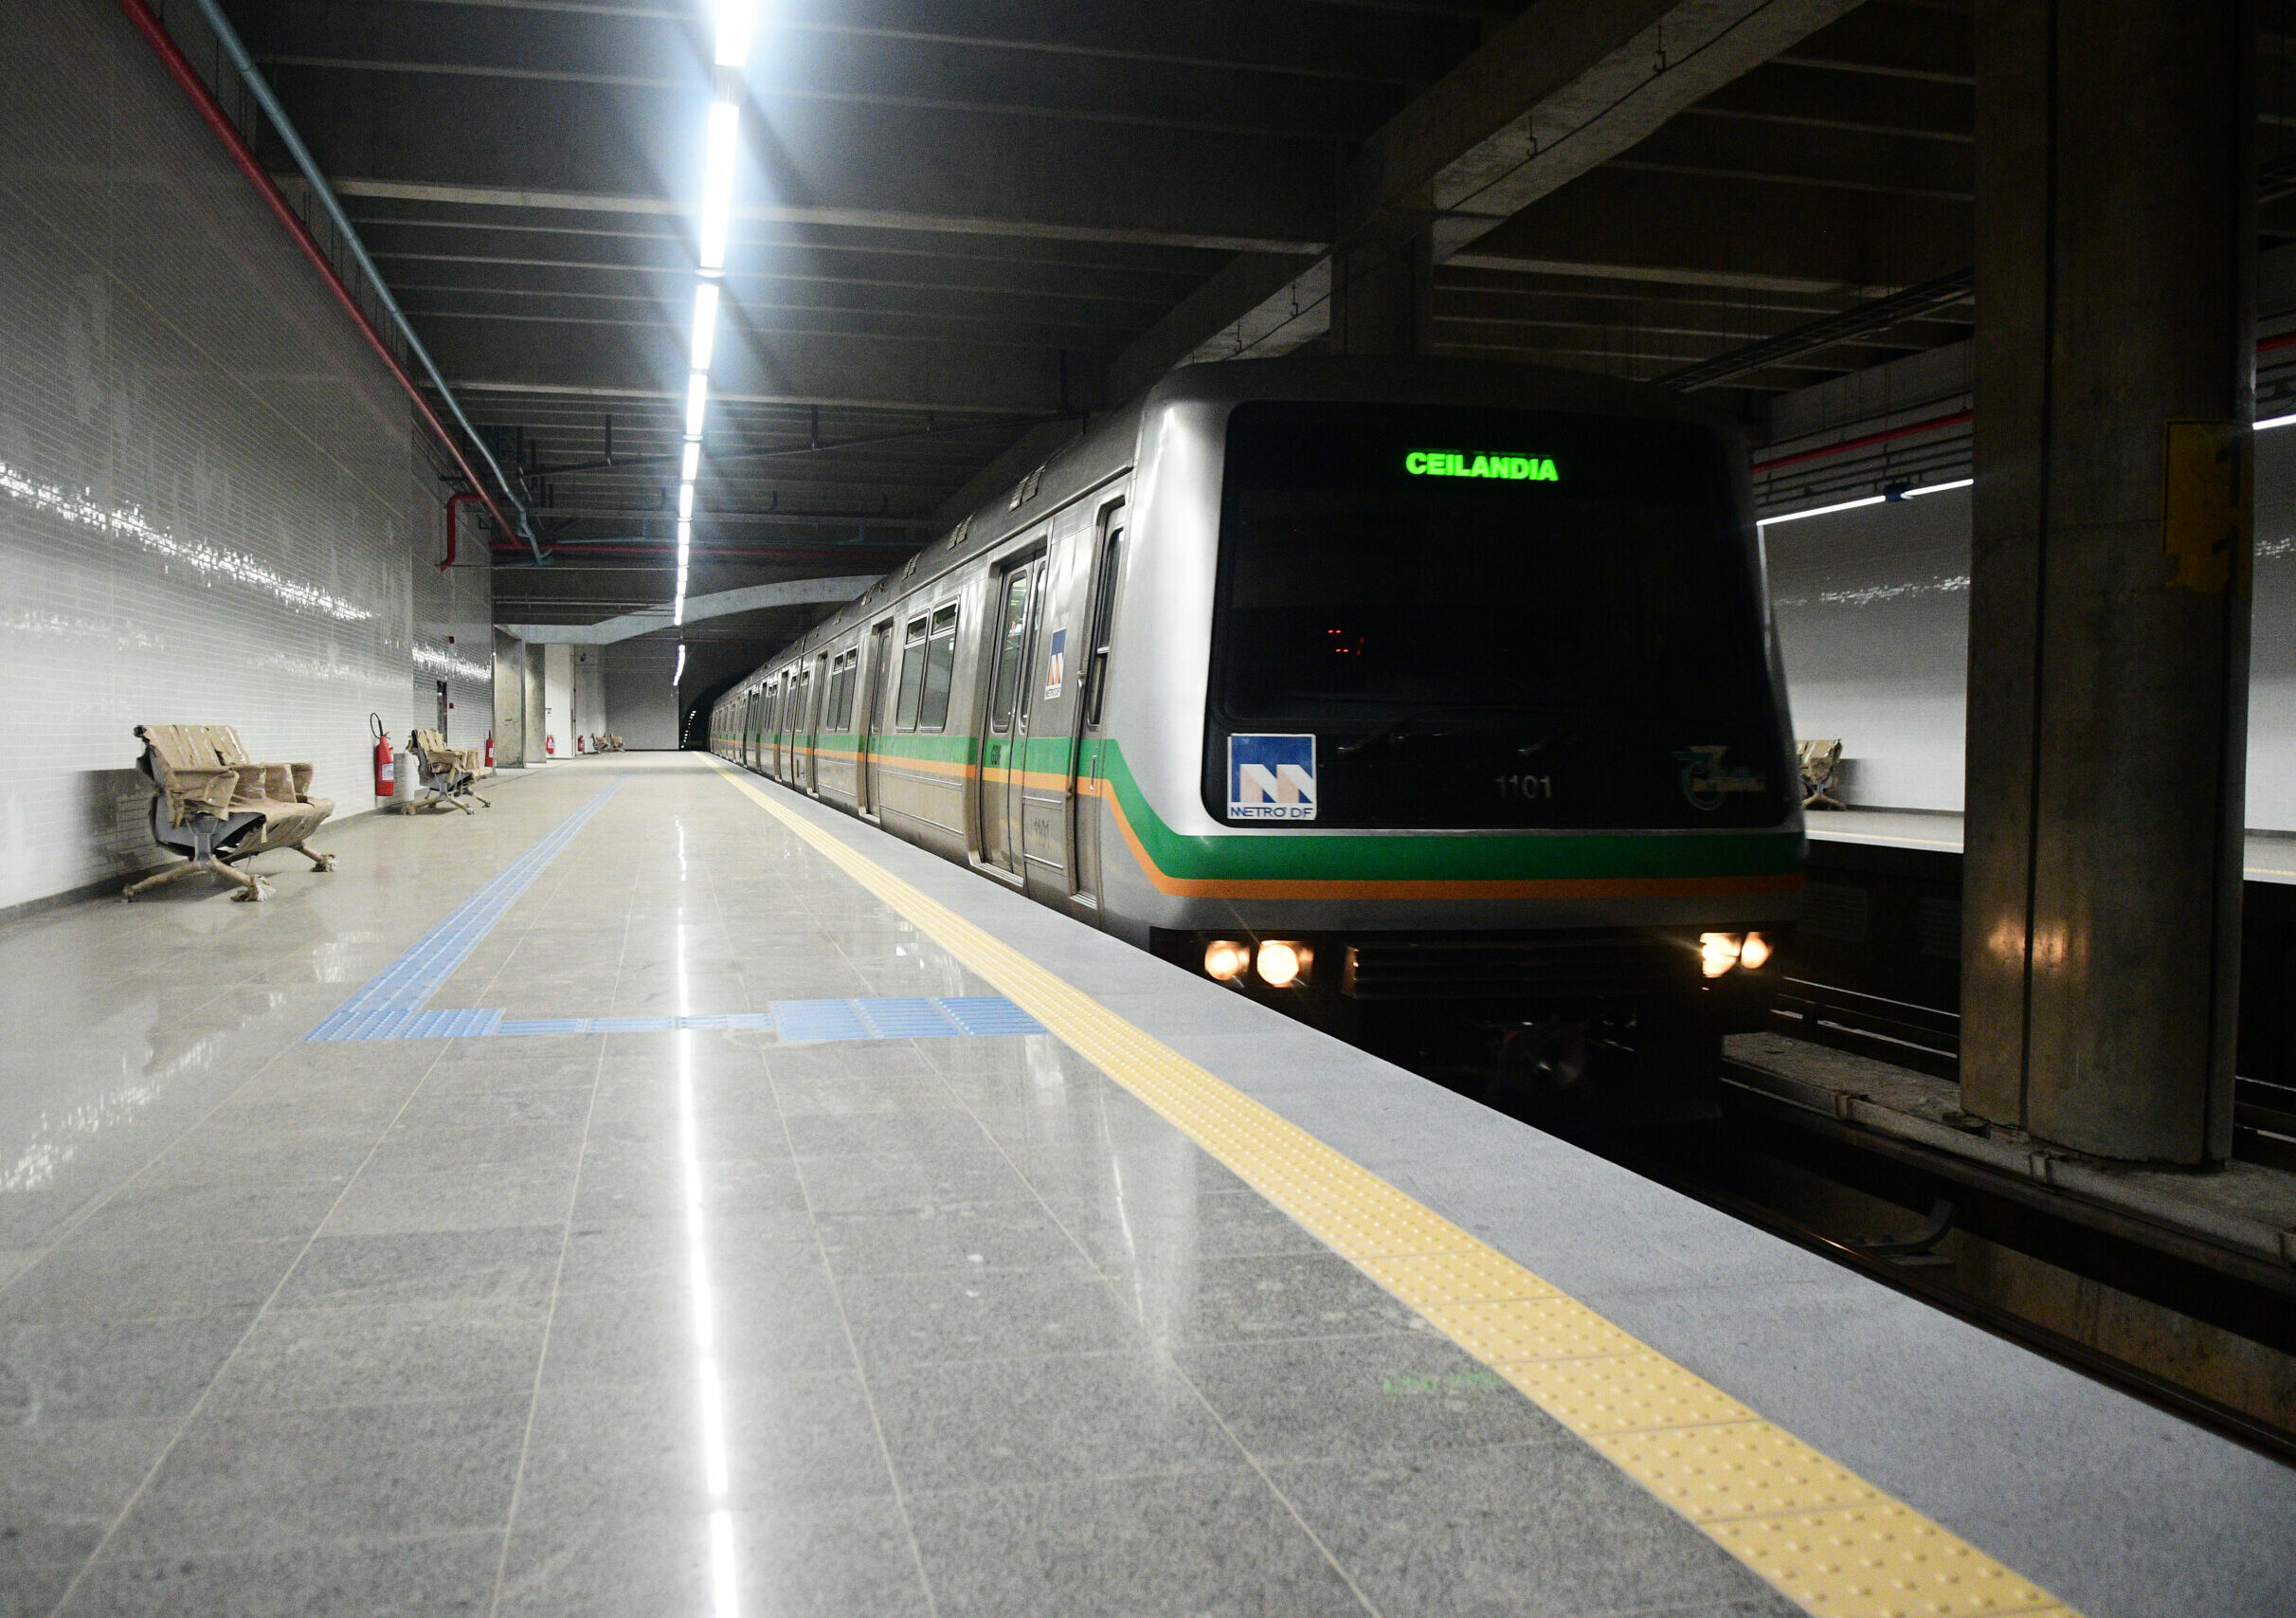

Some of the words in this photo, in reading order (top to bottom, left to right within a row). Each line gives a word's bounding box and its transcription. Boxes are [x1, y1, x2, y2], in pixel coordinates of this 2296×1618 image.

[1405, 451, 1560, 482] CEILANDIA
[1494, 773, 1553, 800] 1101
[1291, 808, 1313, 818] DF
